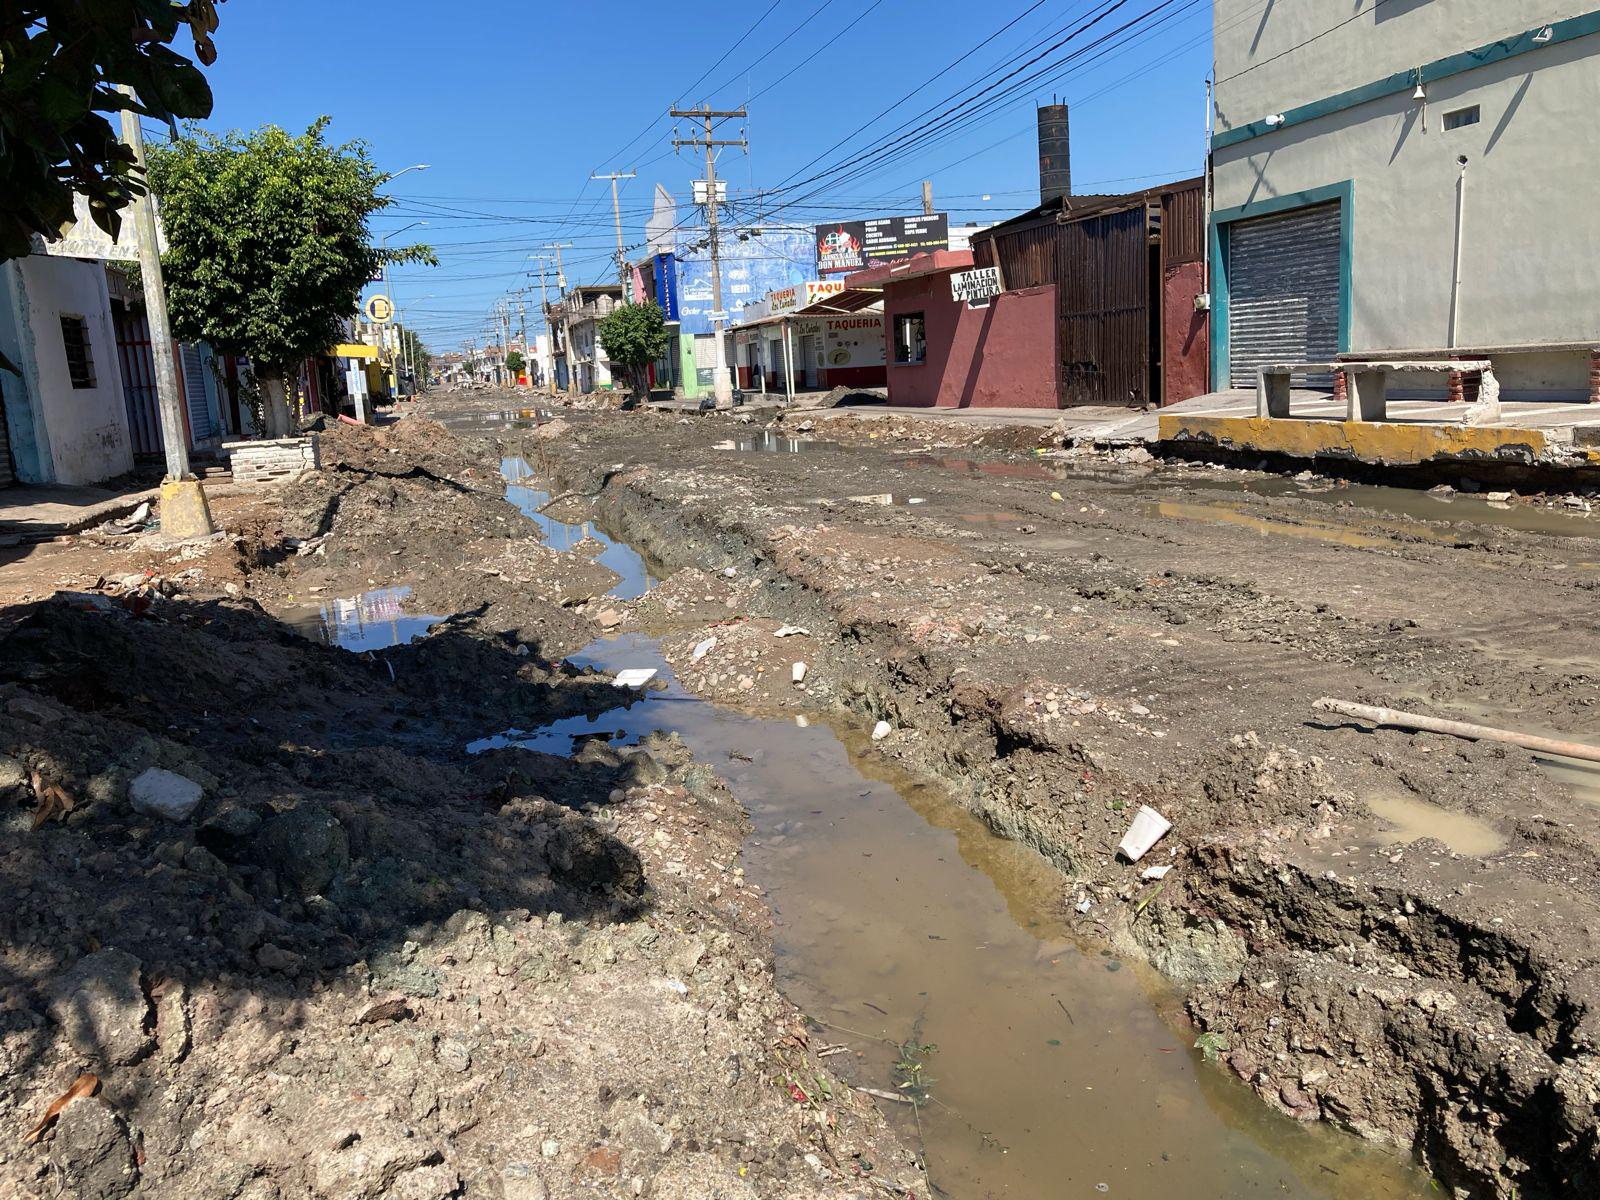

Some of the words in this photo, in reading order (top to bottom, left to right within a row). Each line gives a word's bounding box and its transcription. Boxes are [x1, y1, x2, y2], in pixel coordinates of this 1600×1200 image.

[818, 260, 833, 269] DON
[835, 258, 863, 268] MANUEL
[960, 269, 996, 281] TALLER
[808, 283, 842, 294] TAQU
[953, 277, 998, 292] LAMINACION
[771, 288, 795, 301] TAQUERIA
[957, 292, 963, 300] Y
[966, 286, 1000, 300] PINTURA
[826, 319, 882, 330] TAQUERIA
